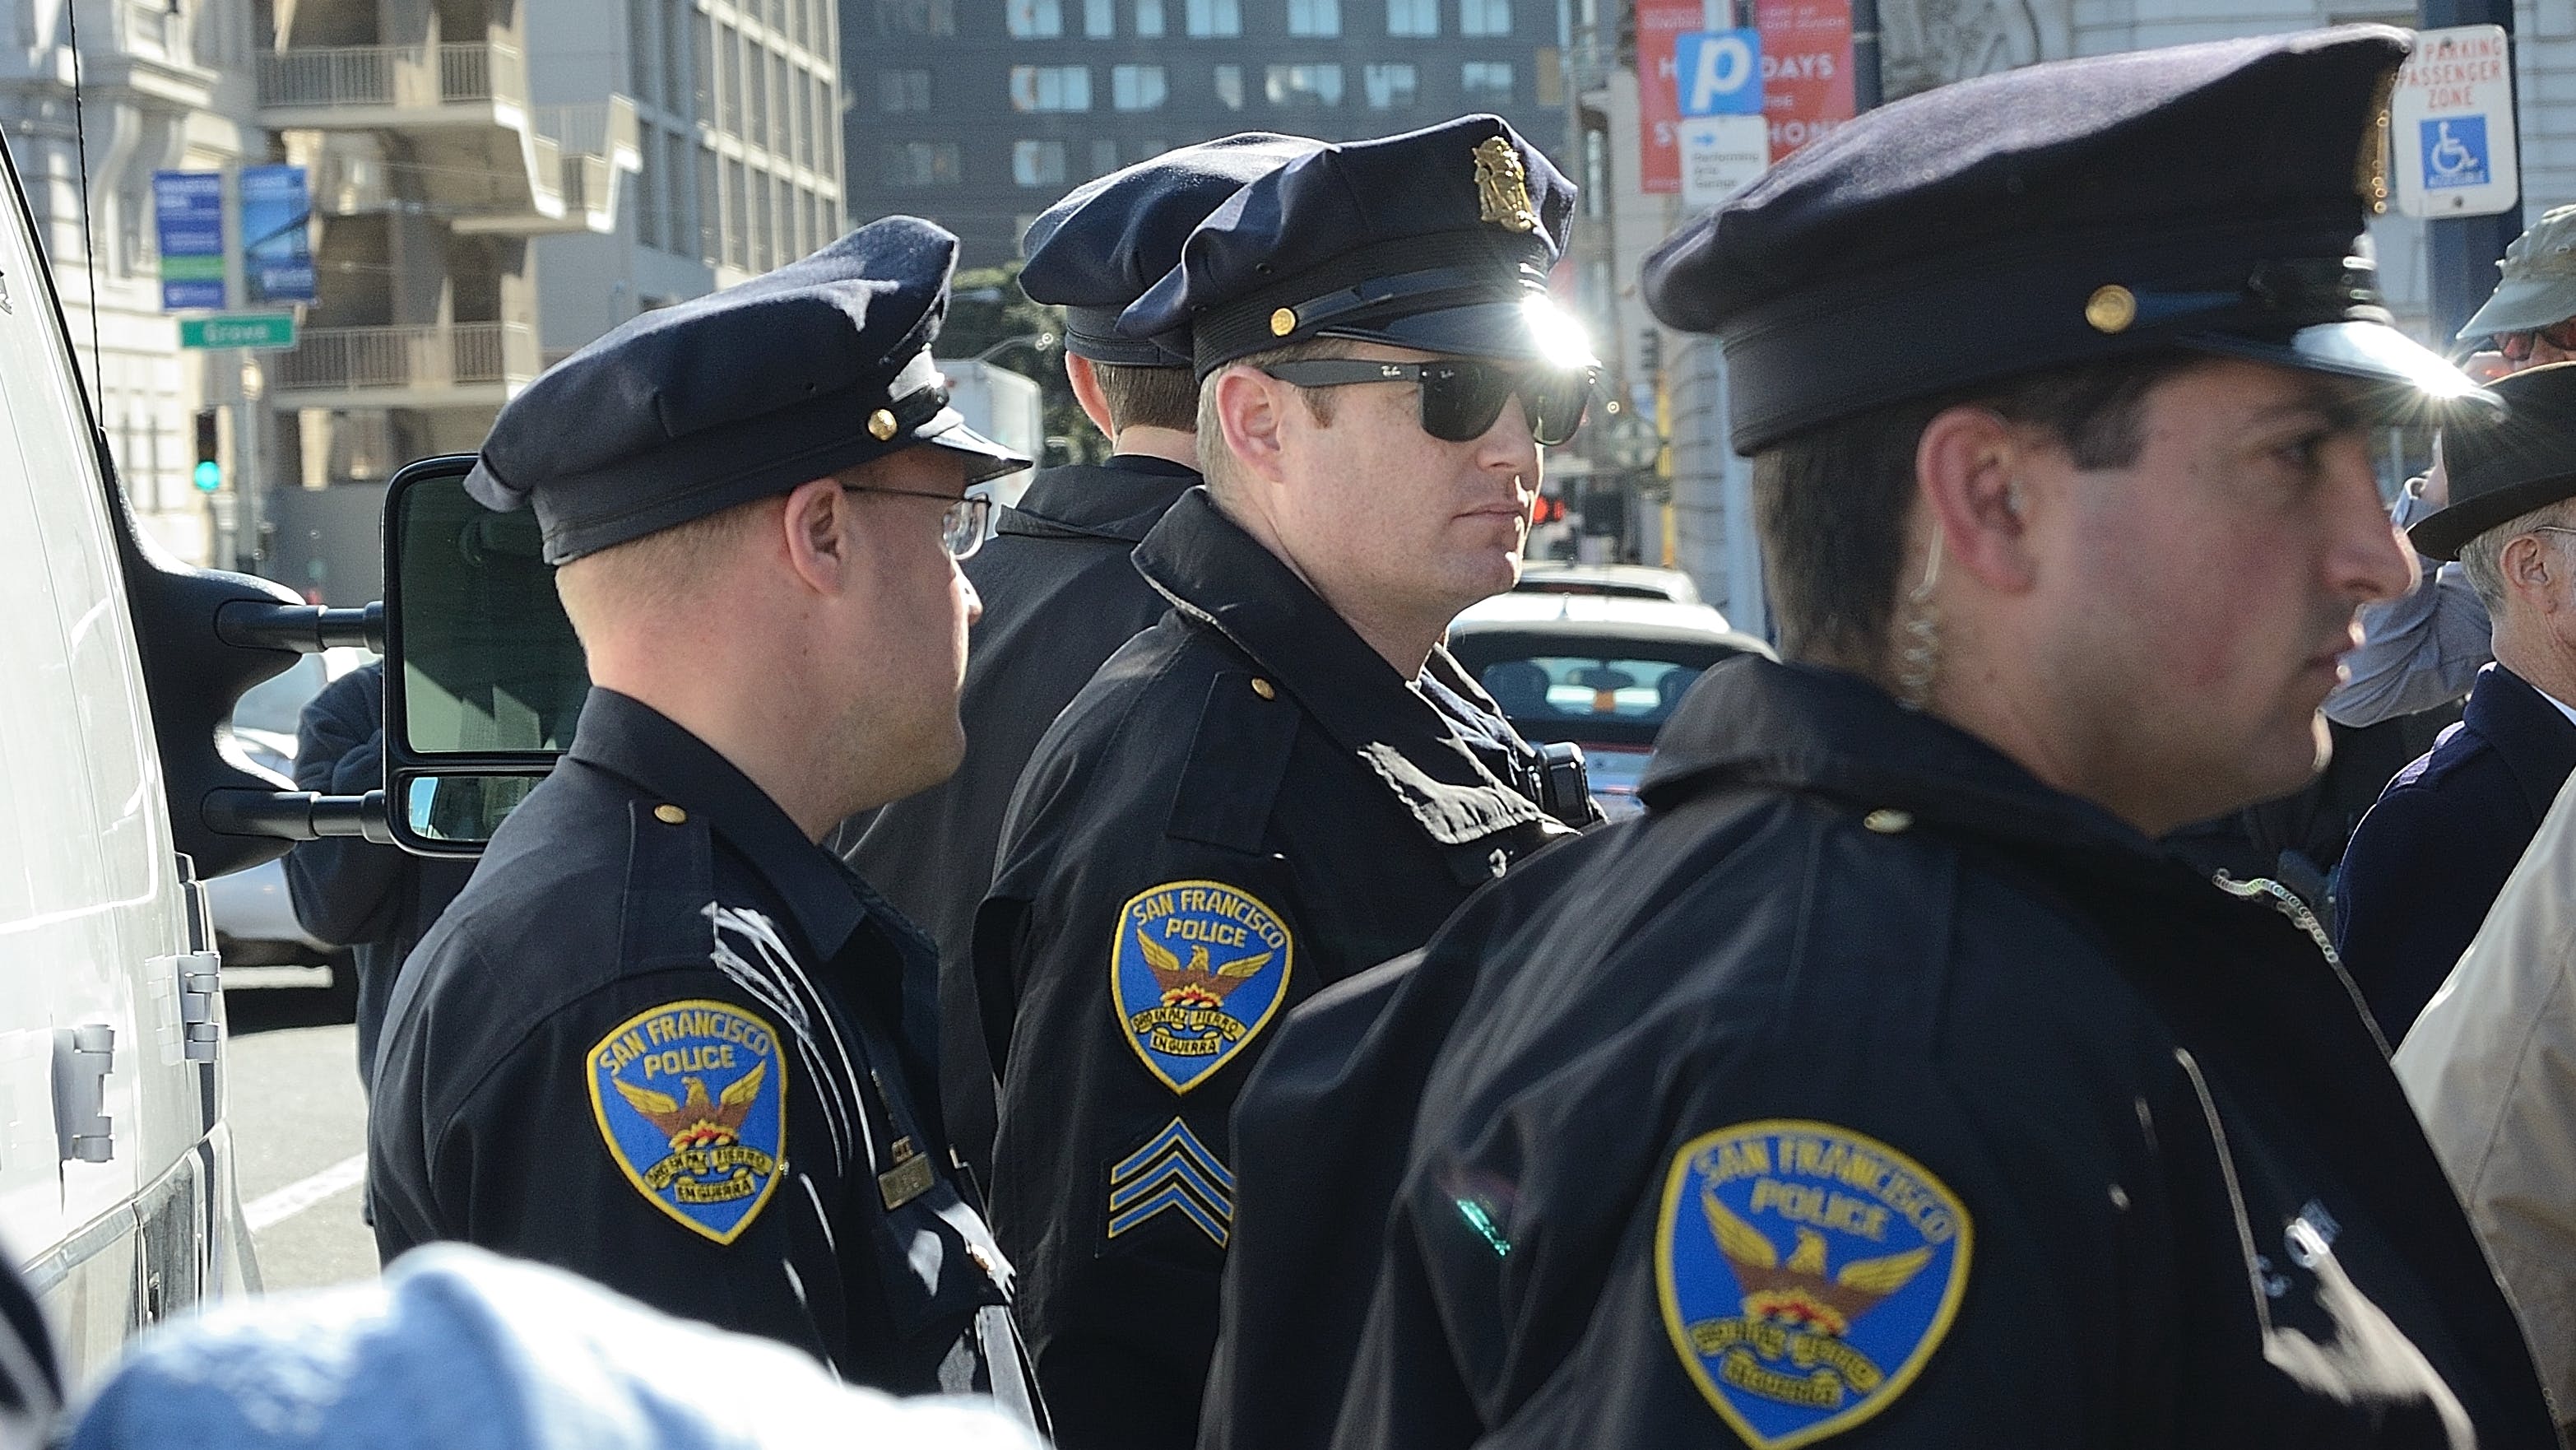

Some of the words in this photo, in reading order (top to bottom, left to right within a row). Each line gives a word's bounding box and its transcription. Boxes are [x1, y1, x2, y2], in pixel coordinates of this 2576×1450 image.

[2425, 36, 2502, 61] PARKING
[2399, 59, 2502, 87] PASSENGER
[2428, 86, 2475, 108] ZONE
[1133, 893, 1175, 927] SAN
[1181, 889, 1285, 949] FRANCISCO
[1165, 918, 1248, 948] POLICE
[600, 1031, 646, 1076] SAN
[646, 1011, 772, 1057] FRANCISCO
[643, 1045, 736, 1080] POLICE
[1693, 1140, 1768, 1190] SAN
[1777, 1137, 1956, 1245] FRANCISCO
[1749, 1177, 1889, 1243] POLICE
